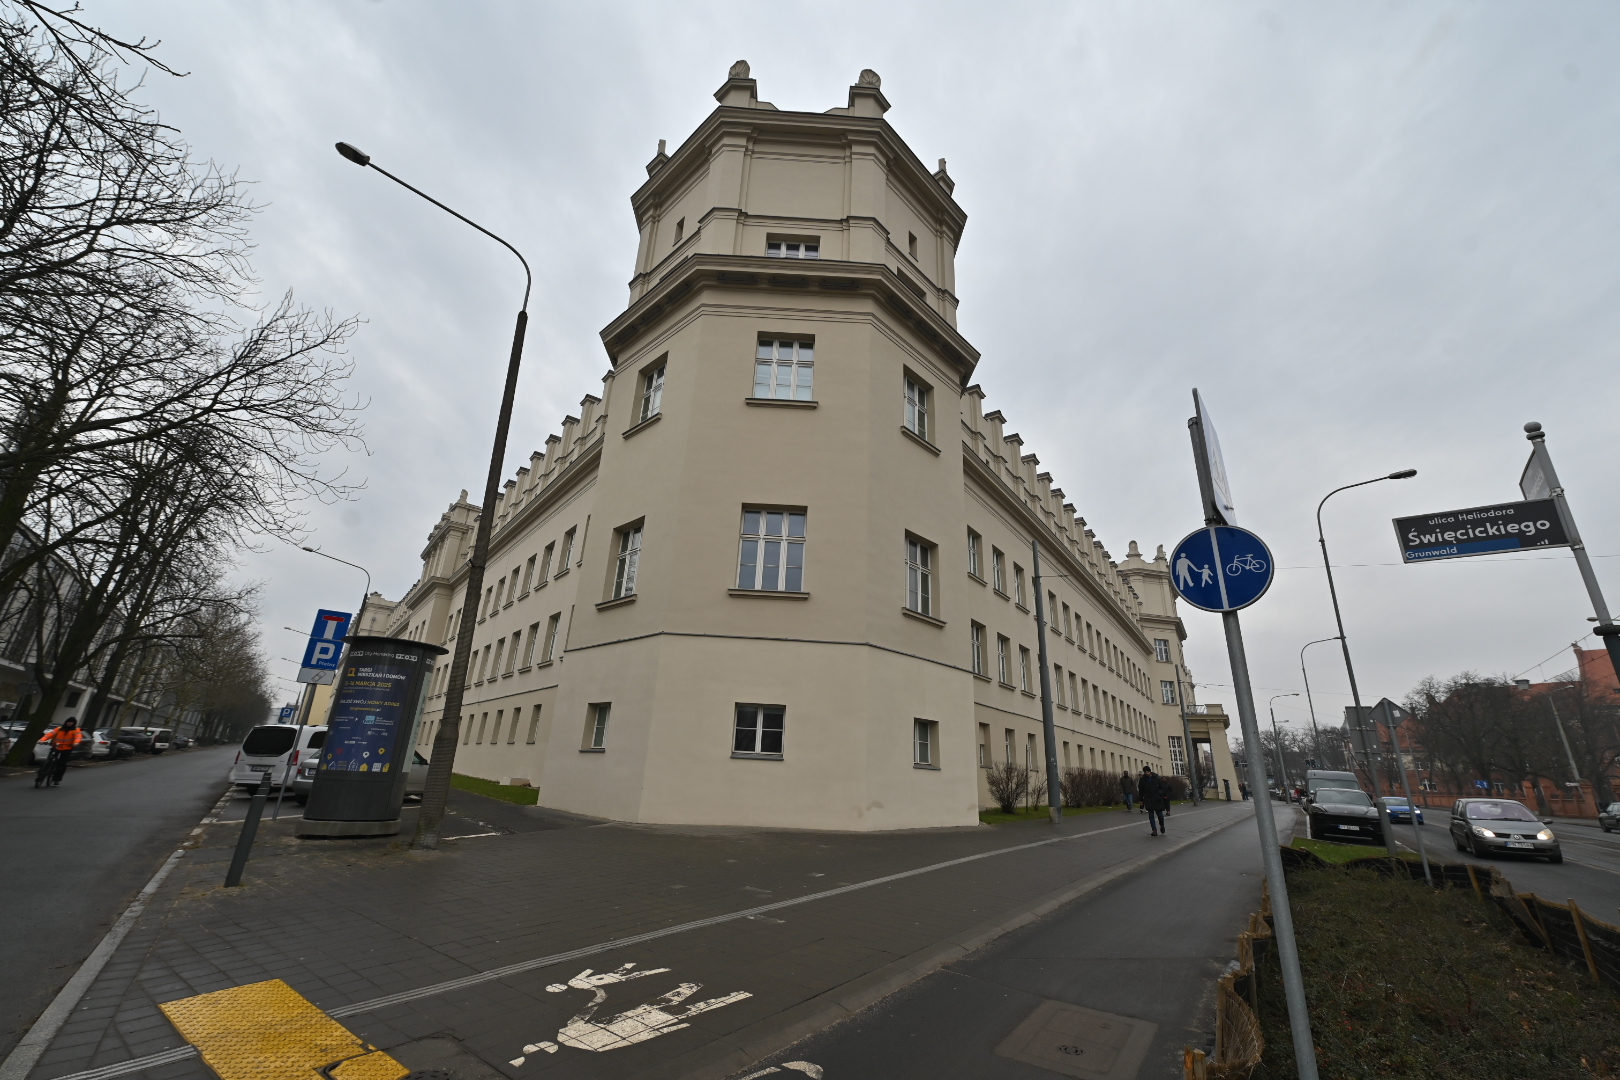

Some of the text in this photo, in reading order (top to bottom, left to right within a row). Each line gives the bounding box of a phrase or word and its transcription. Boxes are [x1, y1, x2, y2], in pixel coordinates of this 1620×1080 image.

[1428, 508, 1515, 526] ulica Heliodora
[1408, 519, 1550, 546] Święcickiego
[1405, 547, 1458, 559] Grunwald
[310, 641, 336, 665] P
[282, 708, 290, 717] P
